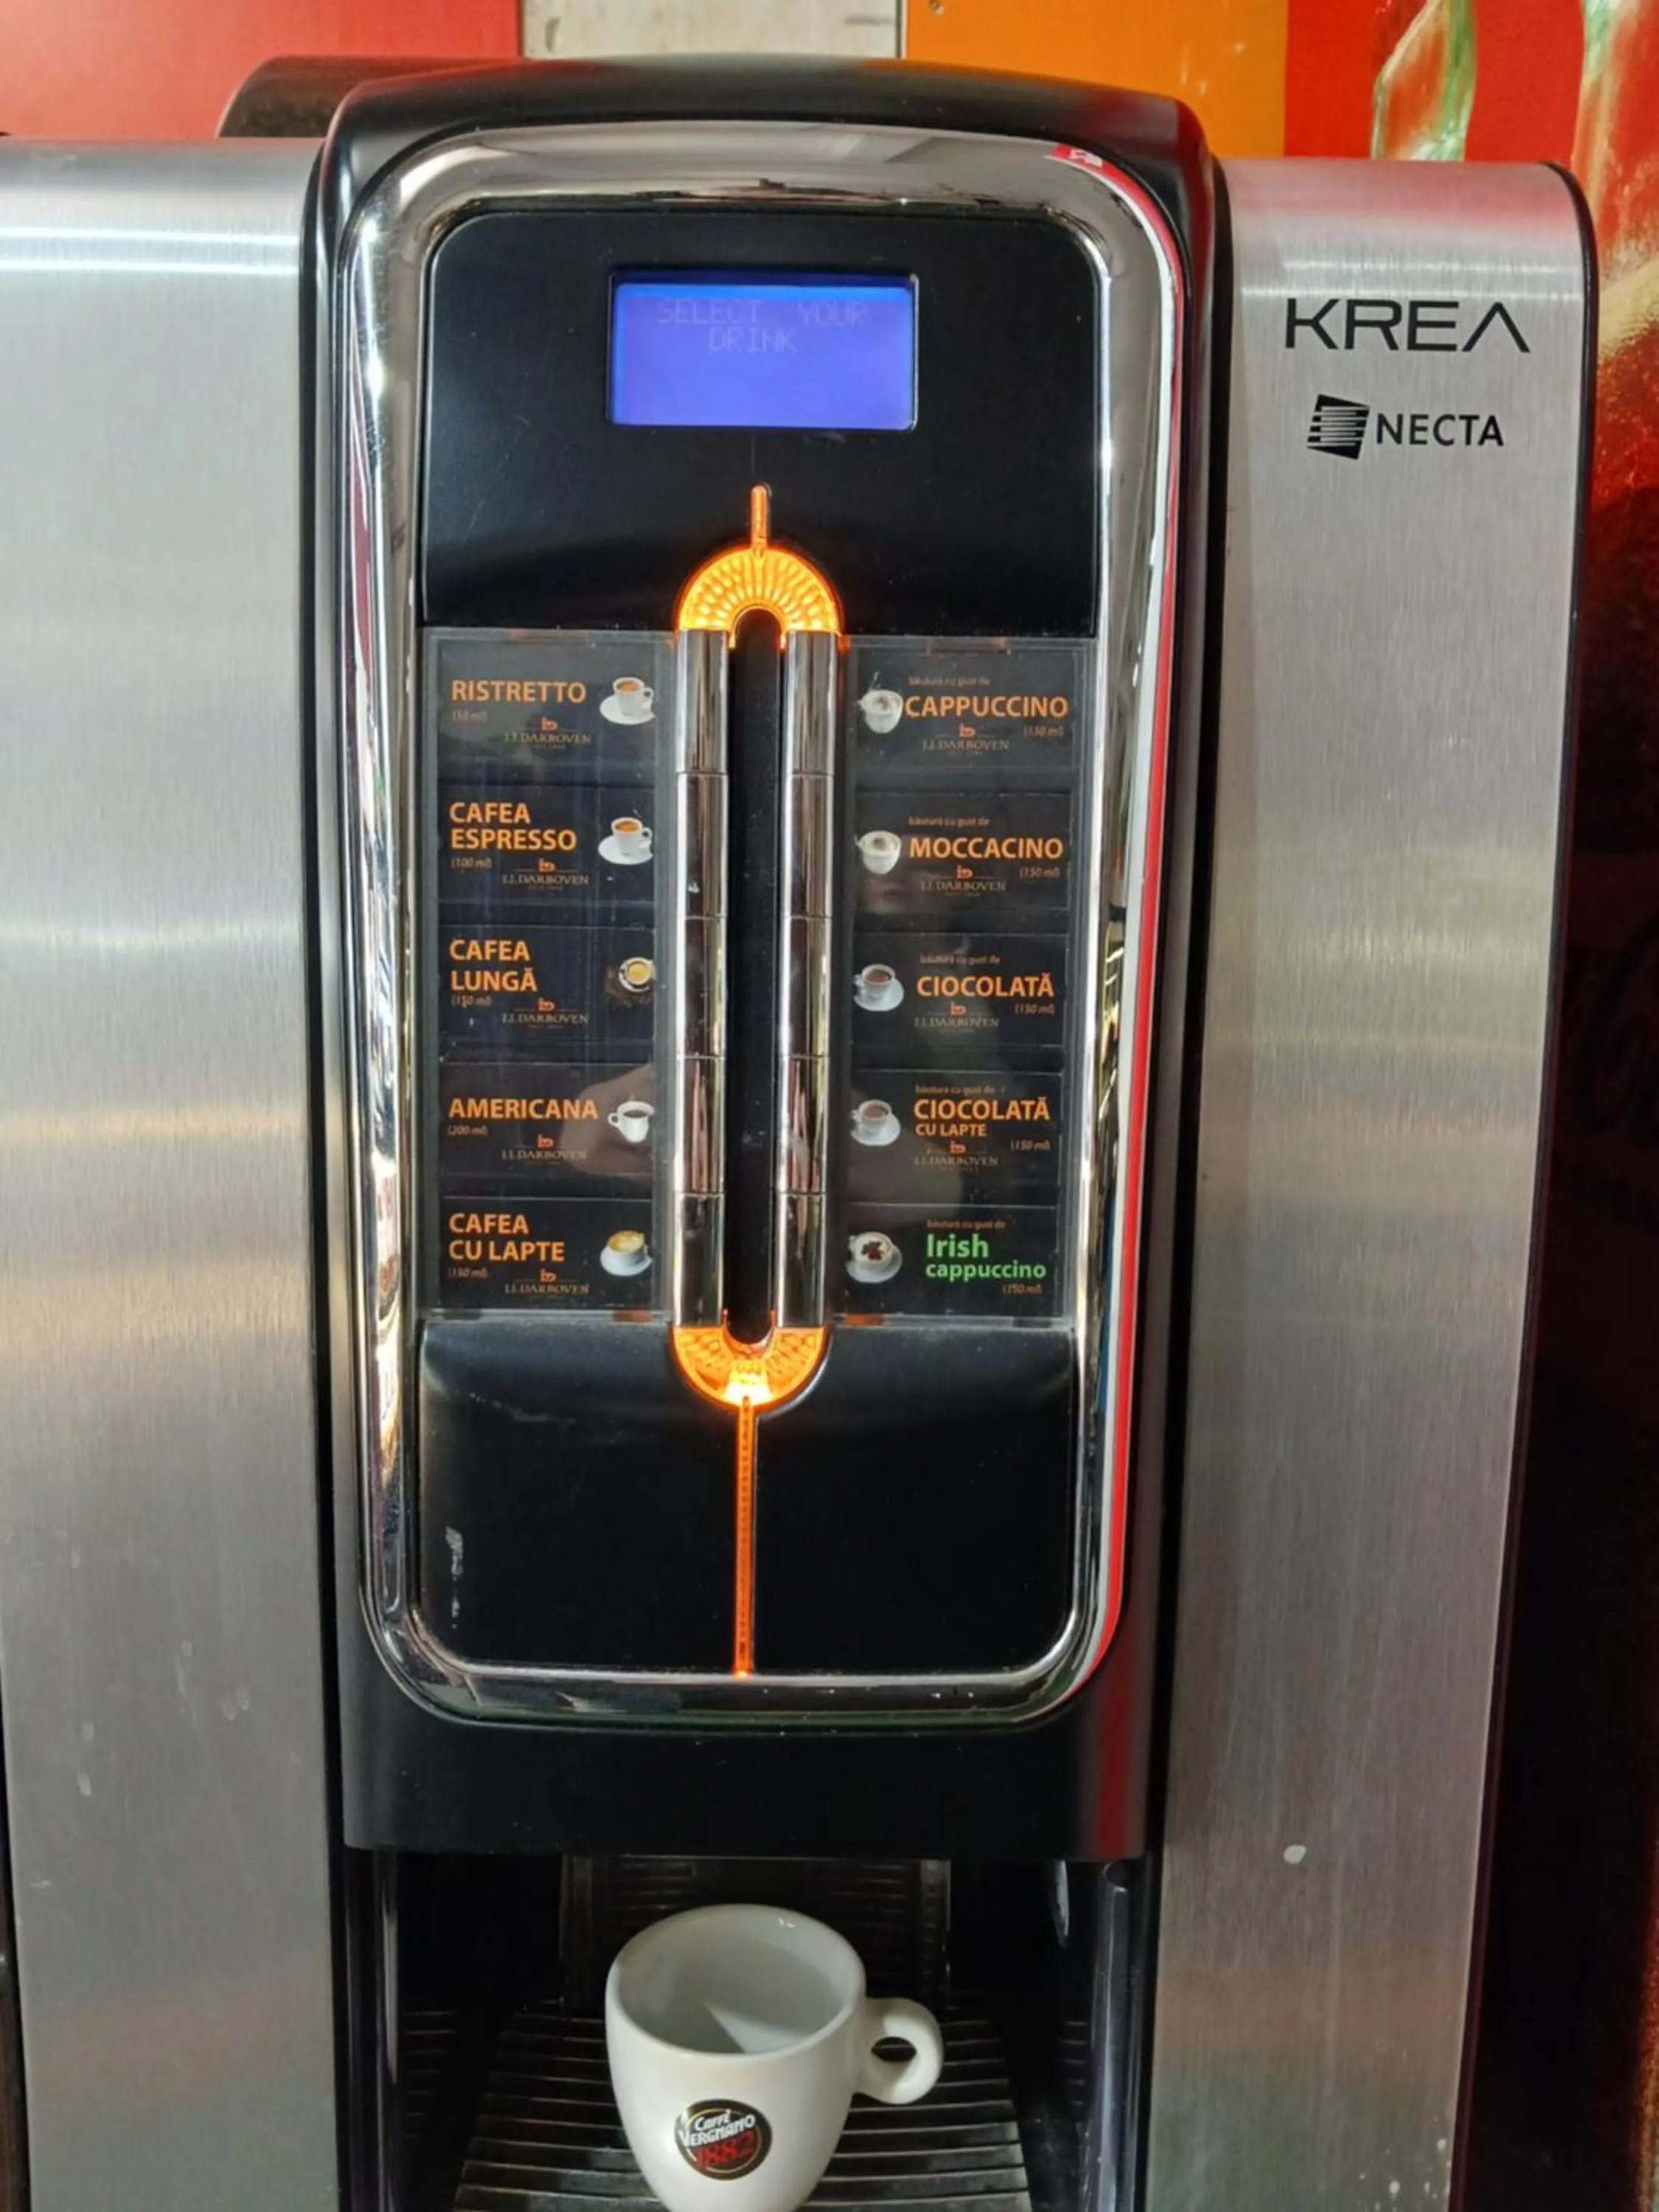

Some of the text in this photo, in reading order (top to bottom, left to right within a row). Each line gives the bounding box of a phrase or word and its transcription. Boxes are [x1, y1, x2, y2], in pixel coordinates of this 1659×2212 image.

[658, 299, 869, 327] SELECT YOUR
[1285, 298, 1531, 353] KREA
[709, 327, 798, 353] DRINK
[1377, 413, 1504, 446] NECTA
[452, 680, 586, 703] RISTRETTO
[905, 696, 1068, 717] CAPPUCCINO
[449, 802, 531, 824] CAFEA
[451, 829, 577, 850] ESPRESSO
[909, 838, 1063, 859] MOCCACINO
[449, 939, 530, 961] CAFEA
[451, 967, 537, 992] LUNGĂ
[917, 972, 1054, 997] CIOCOLATĂ
[448, 1099, 599, 1119] AMERICANA
[914, 1096, 1050, 1121] CIOCOLATĂ
[916, 1124, 987, 1137] CU LAPTE
[449, 1214, 529, 1235] CAFEA
[449, 1241, 565, 1262] CU LAPTE
[926, 1234, 989, 1258] Irish
[925, 1261, 1046, 1281] cappuccino
